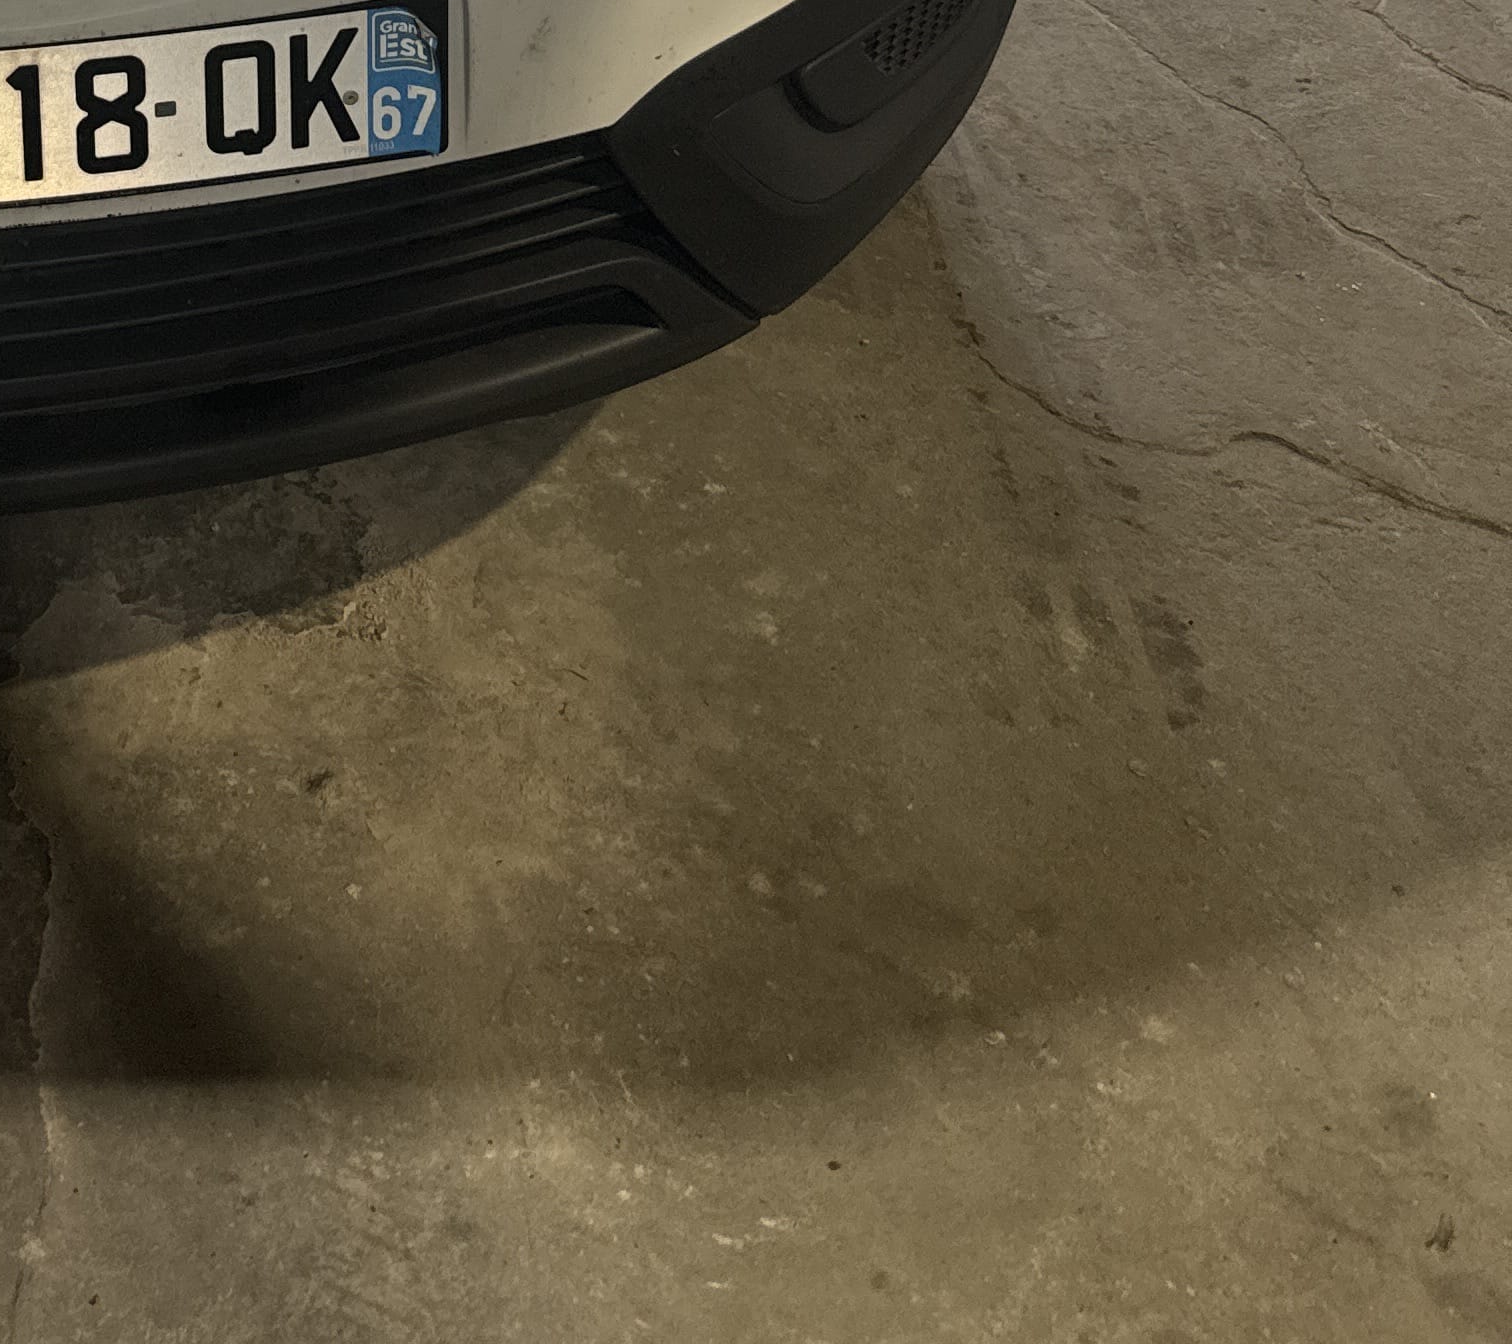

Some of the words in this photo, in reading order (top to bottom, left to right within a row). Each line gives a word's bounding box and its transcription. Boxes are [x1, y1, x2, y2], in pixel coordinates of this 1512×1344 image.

[380, 20, 418, 34] Gran
[380, 33, 428, 60] Est
[372, 84, 437, 140] 67
